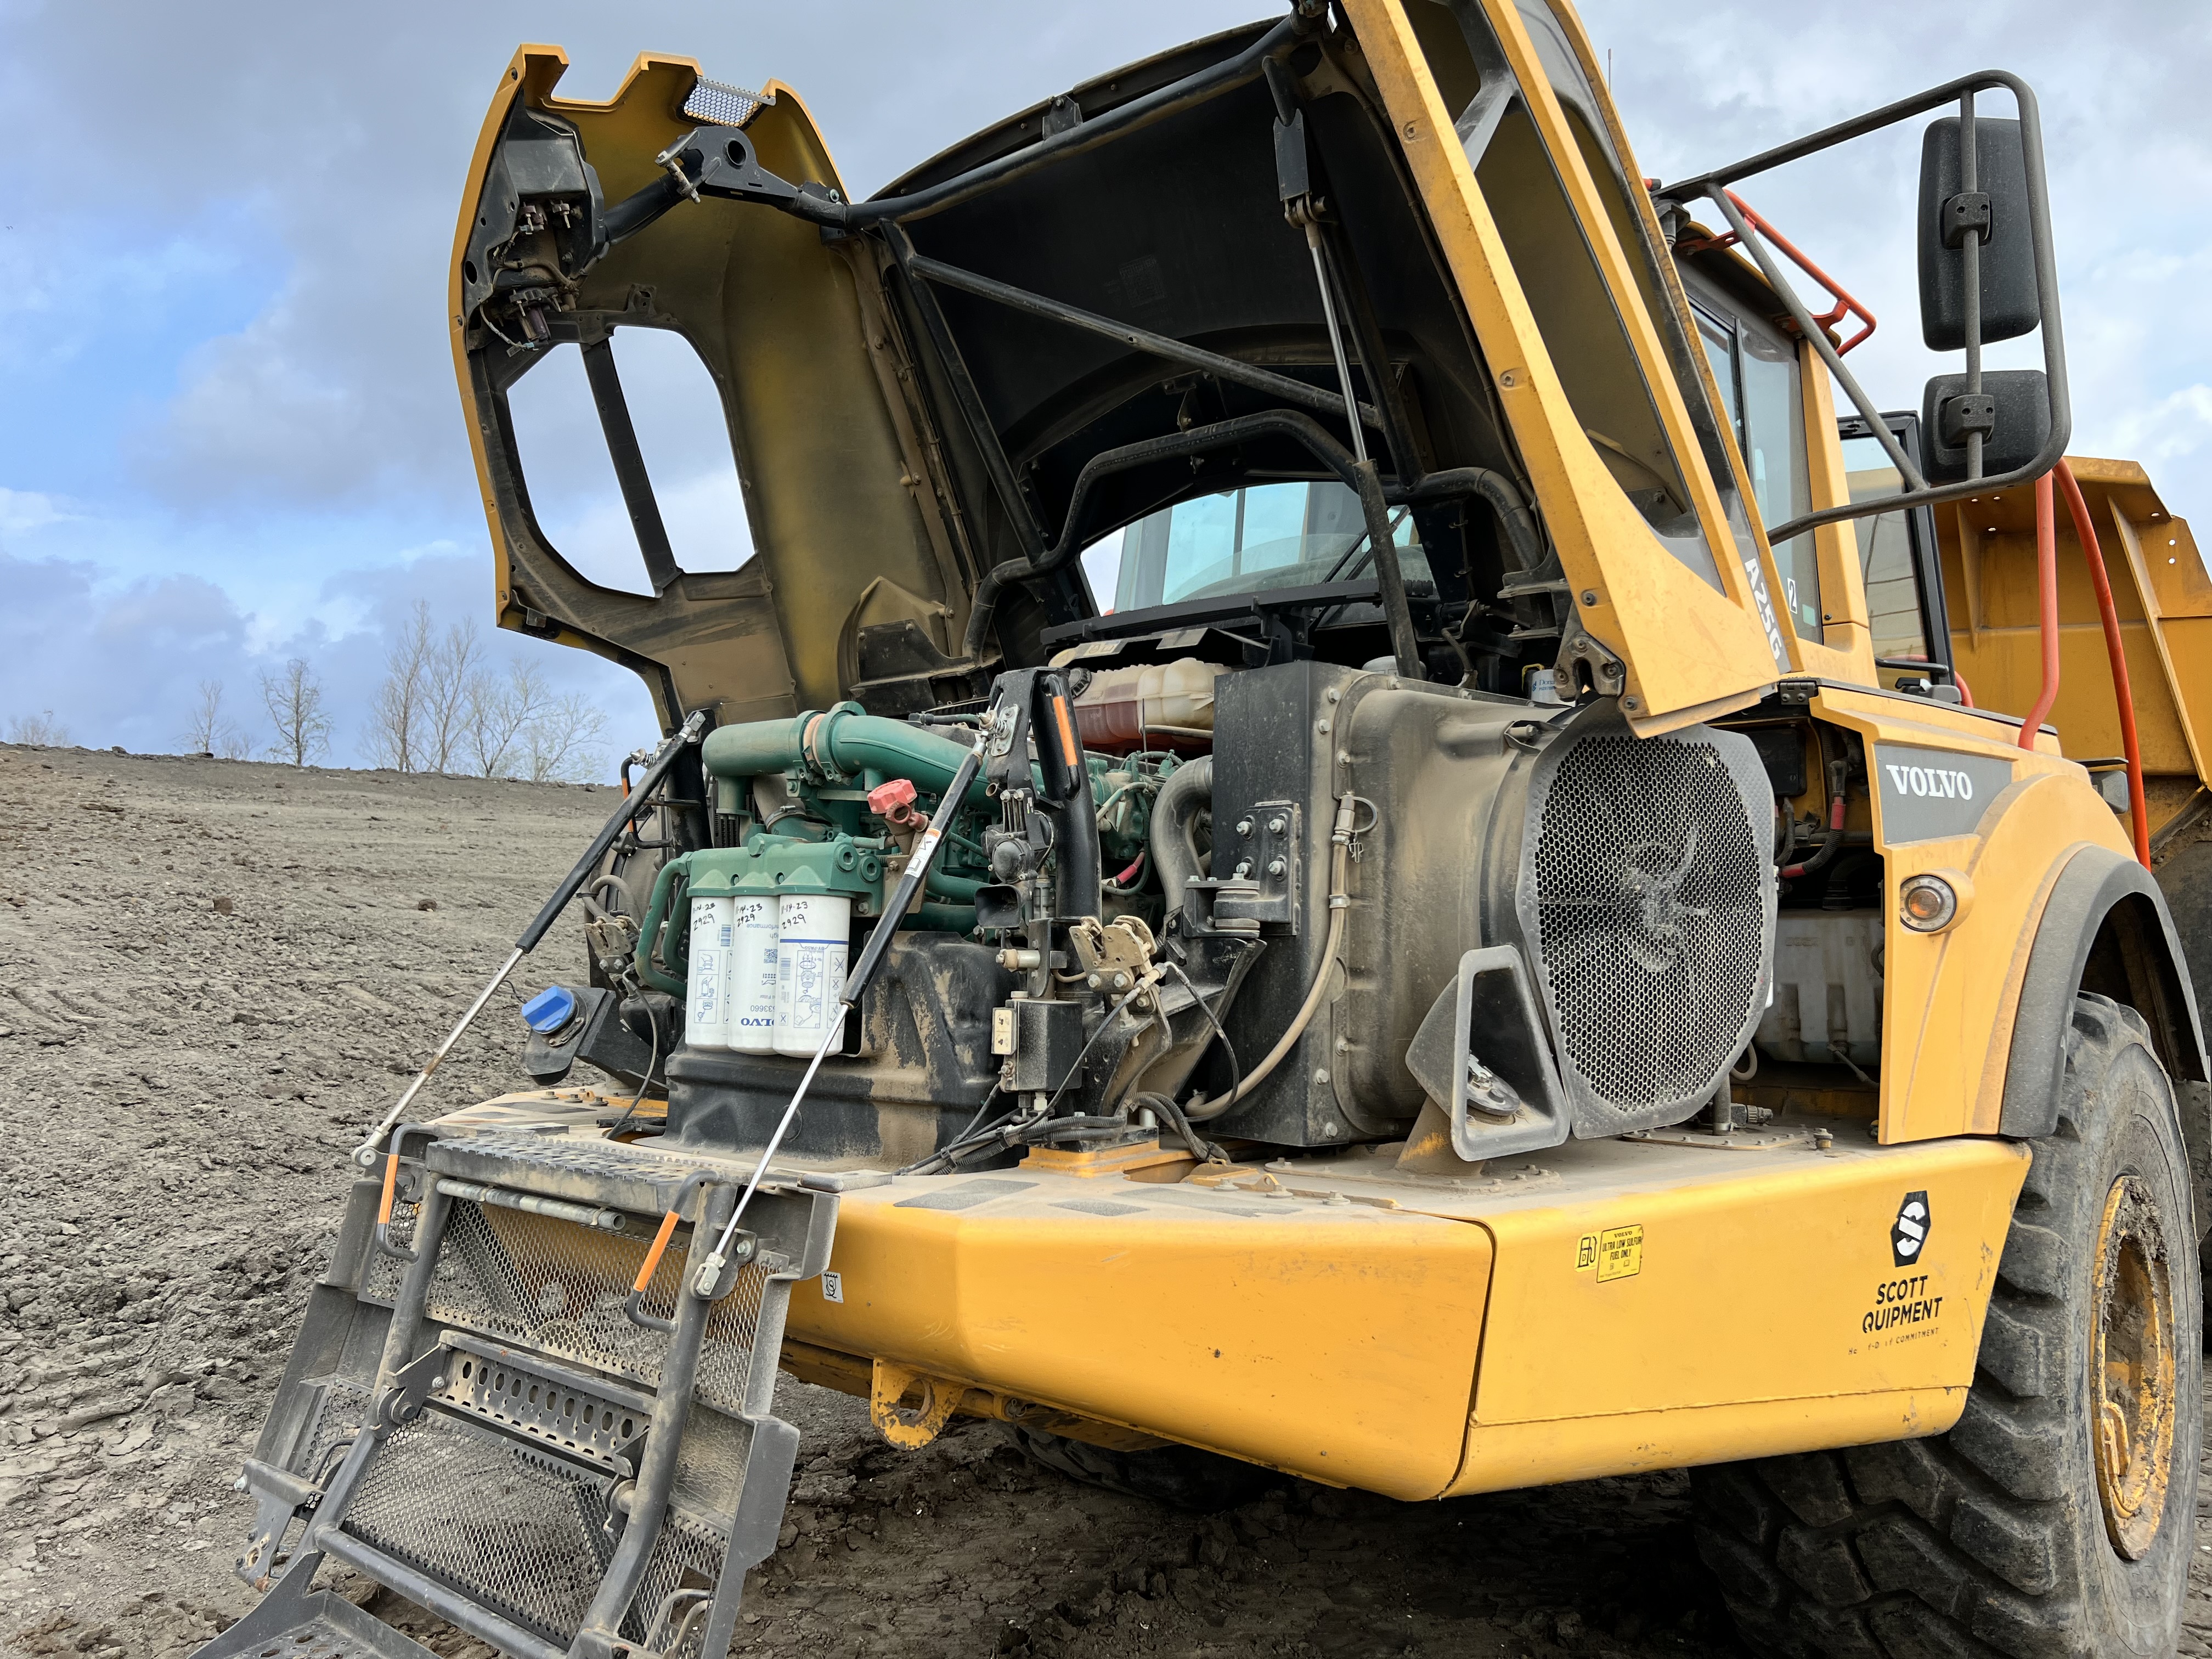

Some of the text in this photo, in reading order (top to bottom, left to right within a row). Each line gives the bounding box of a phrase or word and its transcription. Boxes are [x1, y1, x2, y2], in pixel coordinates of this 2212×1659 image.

[1789, 580, 1796, 612] 2
[1745, 558, 1782, 660] A25G
[1886, 764, 1972, 800] VOLVO
[693, 913, 715, 932] 2929
[782, 914, 806, 930] 2929
[1602, 1241, 1615, 1252] ULTRA
[1616, 1239, 1626, 1249] LOW
[1610, 1248, 1632, 1261] FUEL ONLY
[1875, 1275, 1928, 1305] SCOTT
[1895, 1327, 1939, 1344] COMMITMENT
